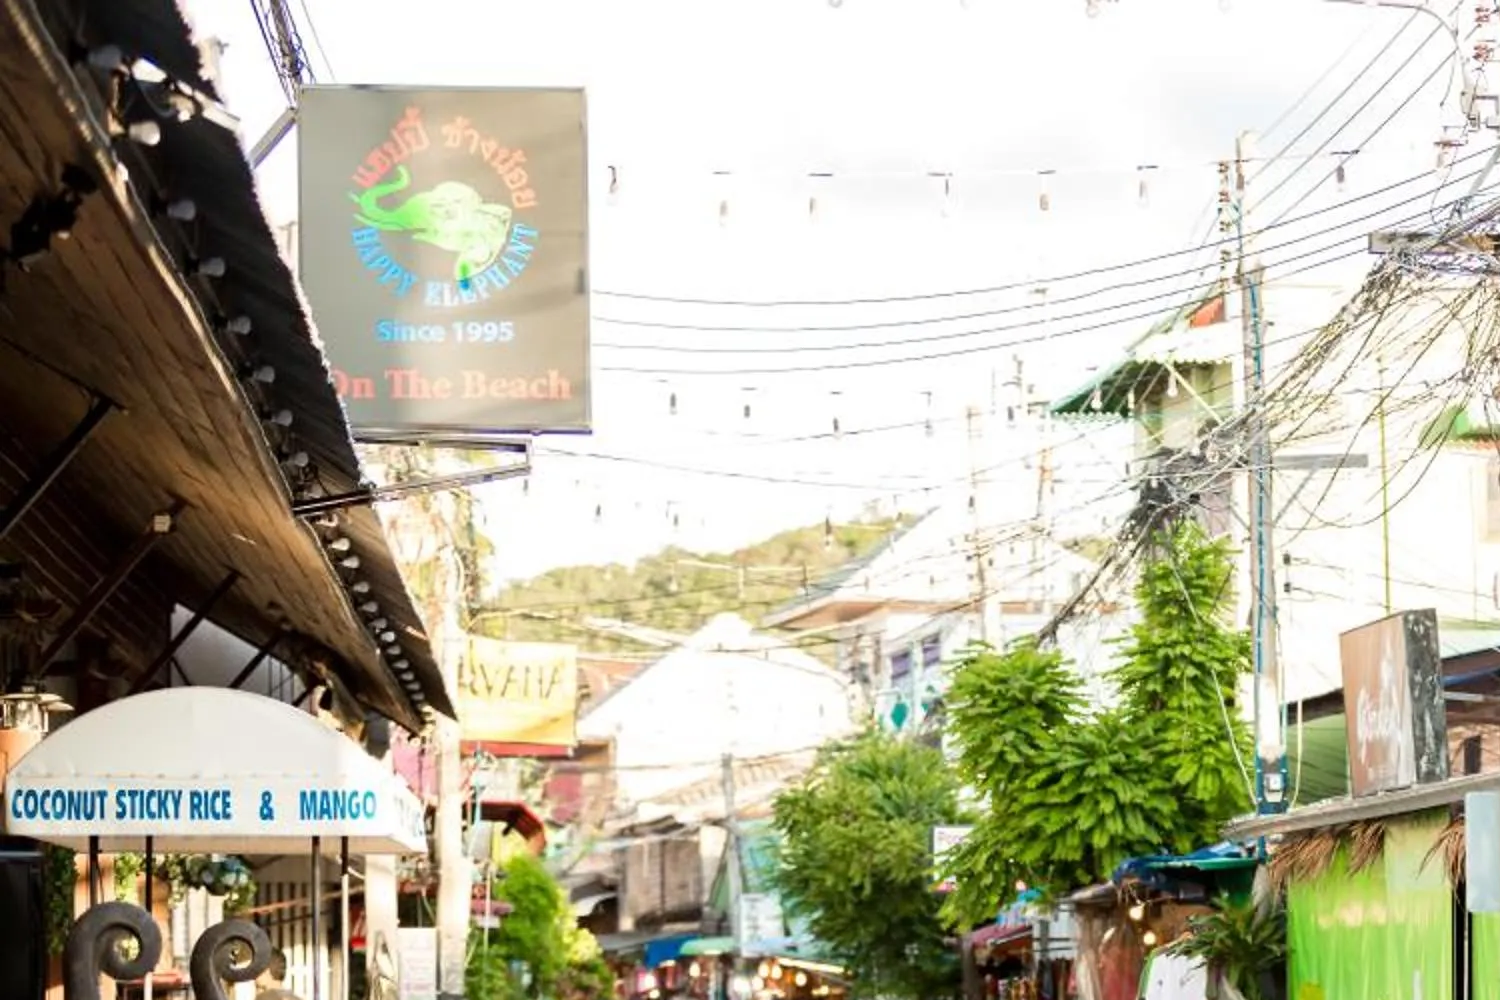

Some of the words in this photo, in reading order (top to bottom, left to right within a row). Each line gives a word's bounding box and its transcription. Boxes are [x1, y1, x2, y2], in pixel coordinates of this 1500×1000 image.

[351, 225, 418, 297] HAPPY
[424, 222, 539, 307] ELEPHANT
[375, 318, 445, 343] Since
[453, 320, 514, 343] 1995
[384, 367, 453, 400] The
[461, 367, 572, 400] Beach
[12, 788, 108, 821] COCONUT
[115, 788, 183, 821] STICKY
[189, 788, 232, 821] RICE
[259, 789, 275, 821] &
[300, 788, 377, 821] MANGO
